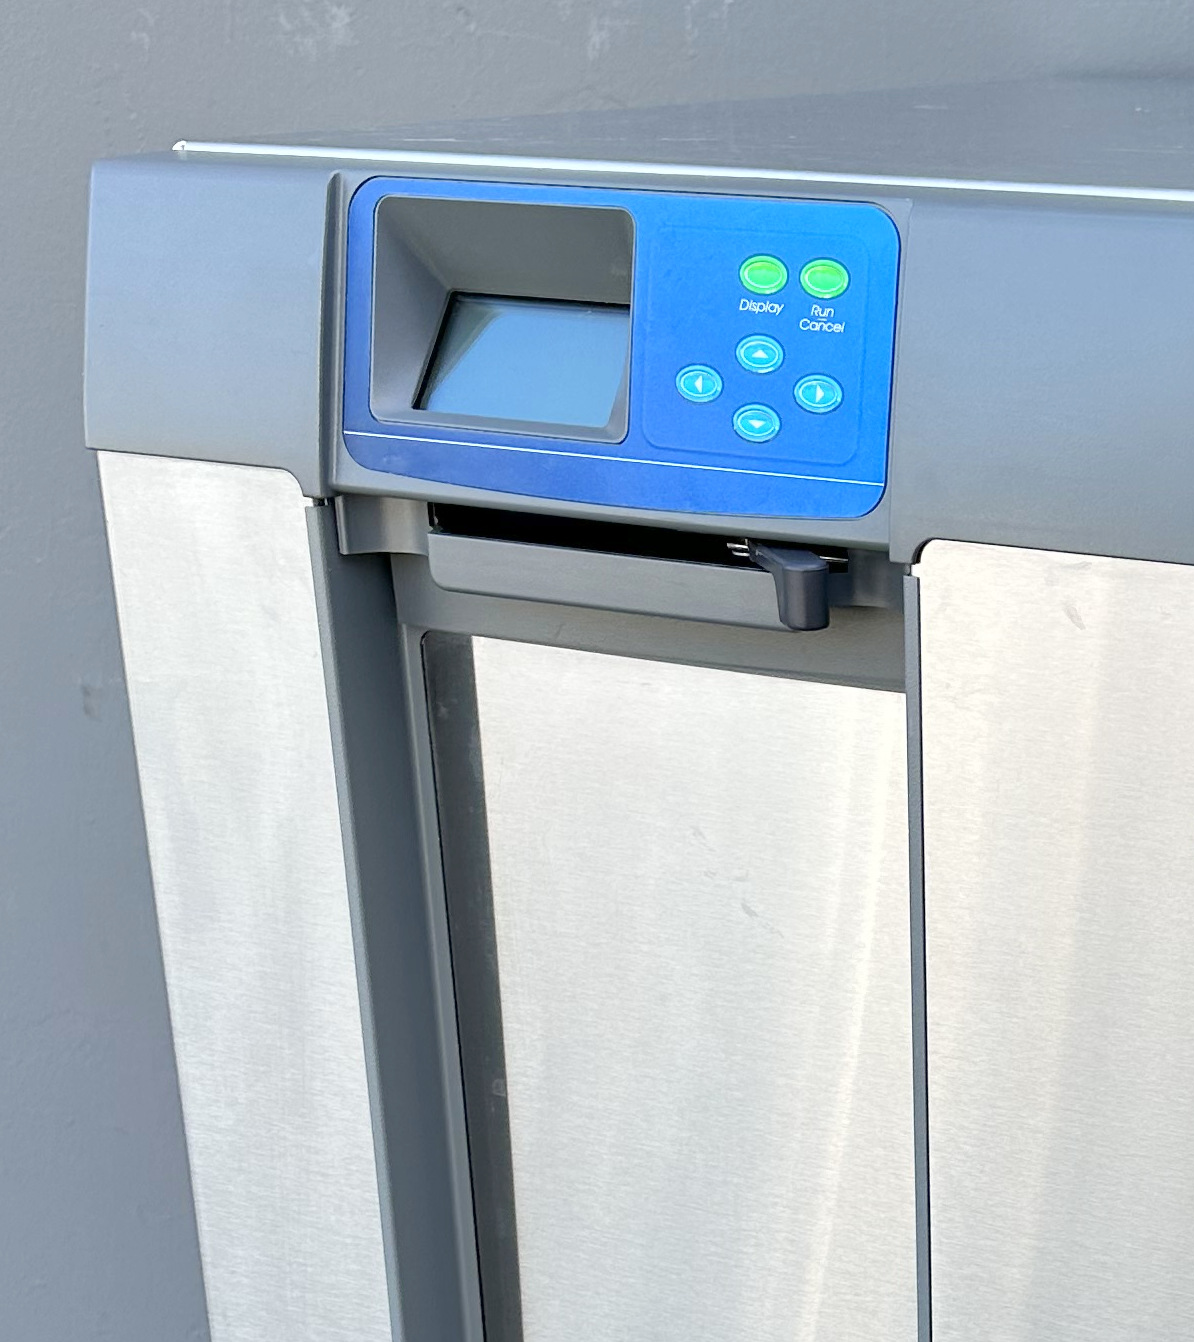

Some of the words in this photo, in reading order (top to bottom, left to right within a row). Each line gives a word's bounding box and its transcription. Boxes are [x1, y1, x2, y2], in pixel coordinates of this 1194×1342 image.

[739, 298, 785, 316] Display
[810, 304, 835, 318] Run
[799, 318, 846, 333] Cancel
